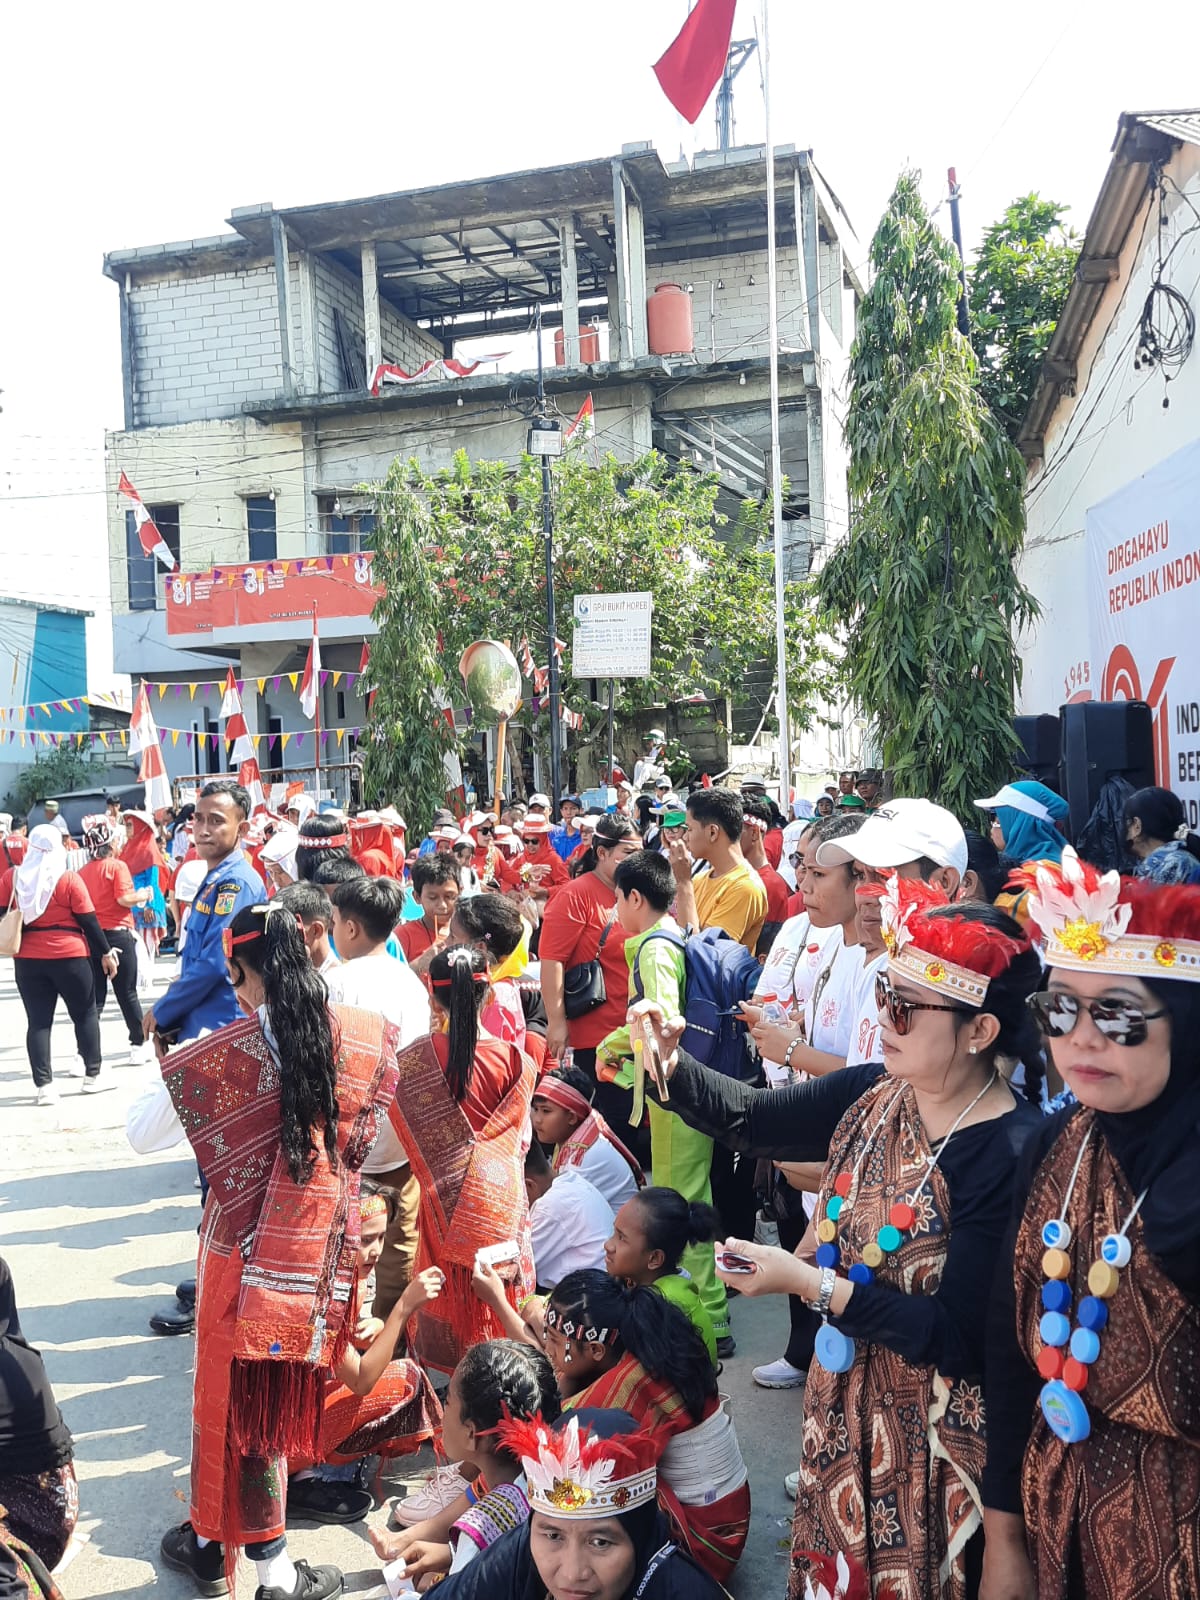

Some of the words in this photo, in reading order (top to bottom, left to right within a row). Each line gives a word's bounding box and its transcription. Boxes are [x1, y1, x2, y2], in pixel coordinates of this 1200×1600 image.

[1108, 519, 1168, 575] DIRGAHAYU
[1109, 568, 1160, 614] REPUBLIK
[1064, 661, 1090, 699] 1945
